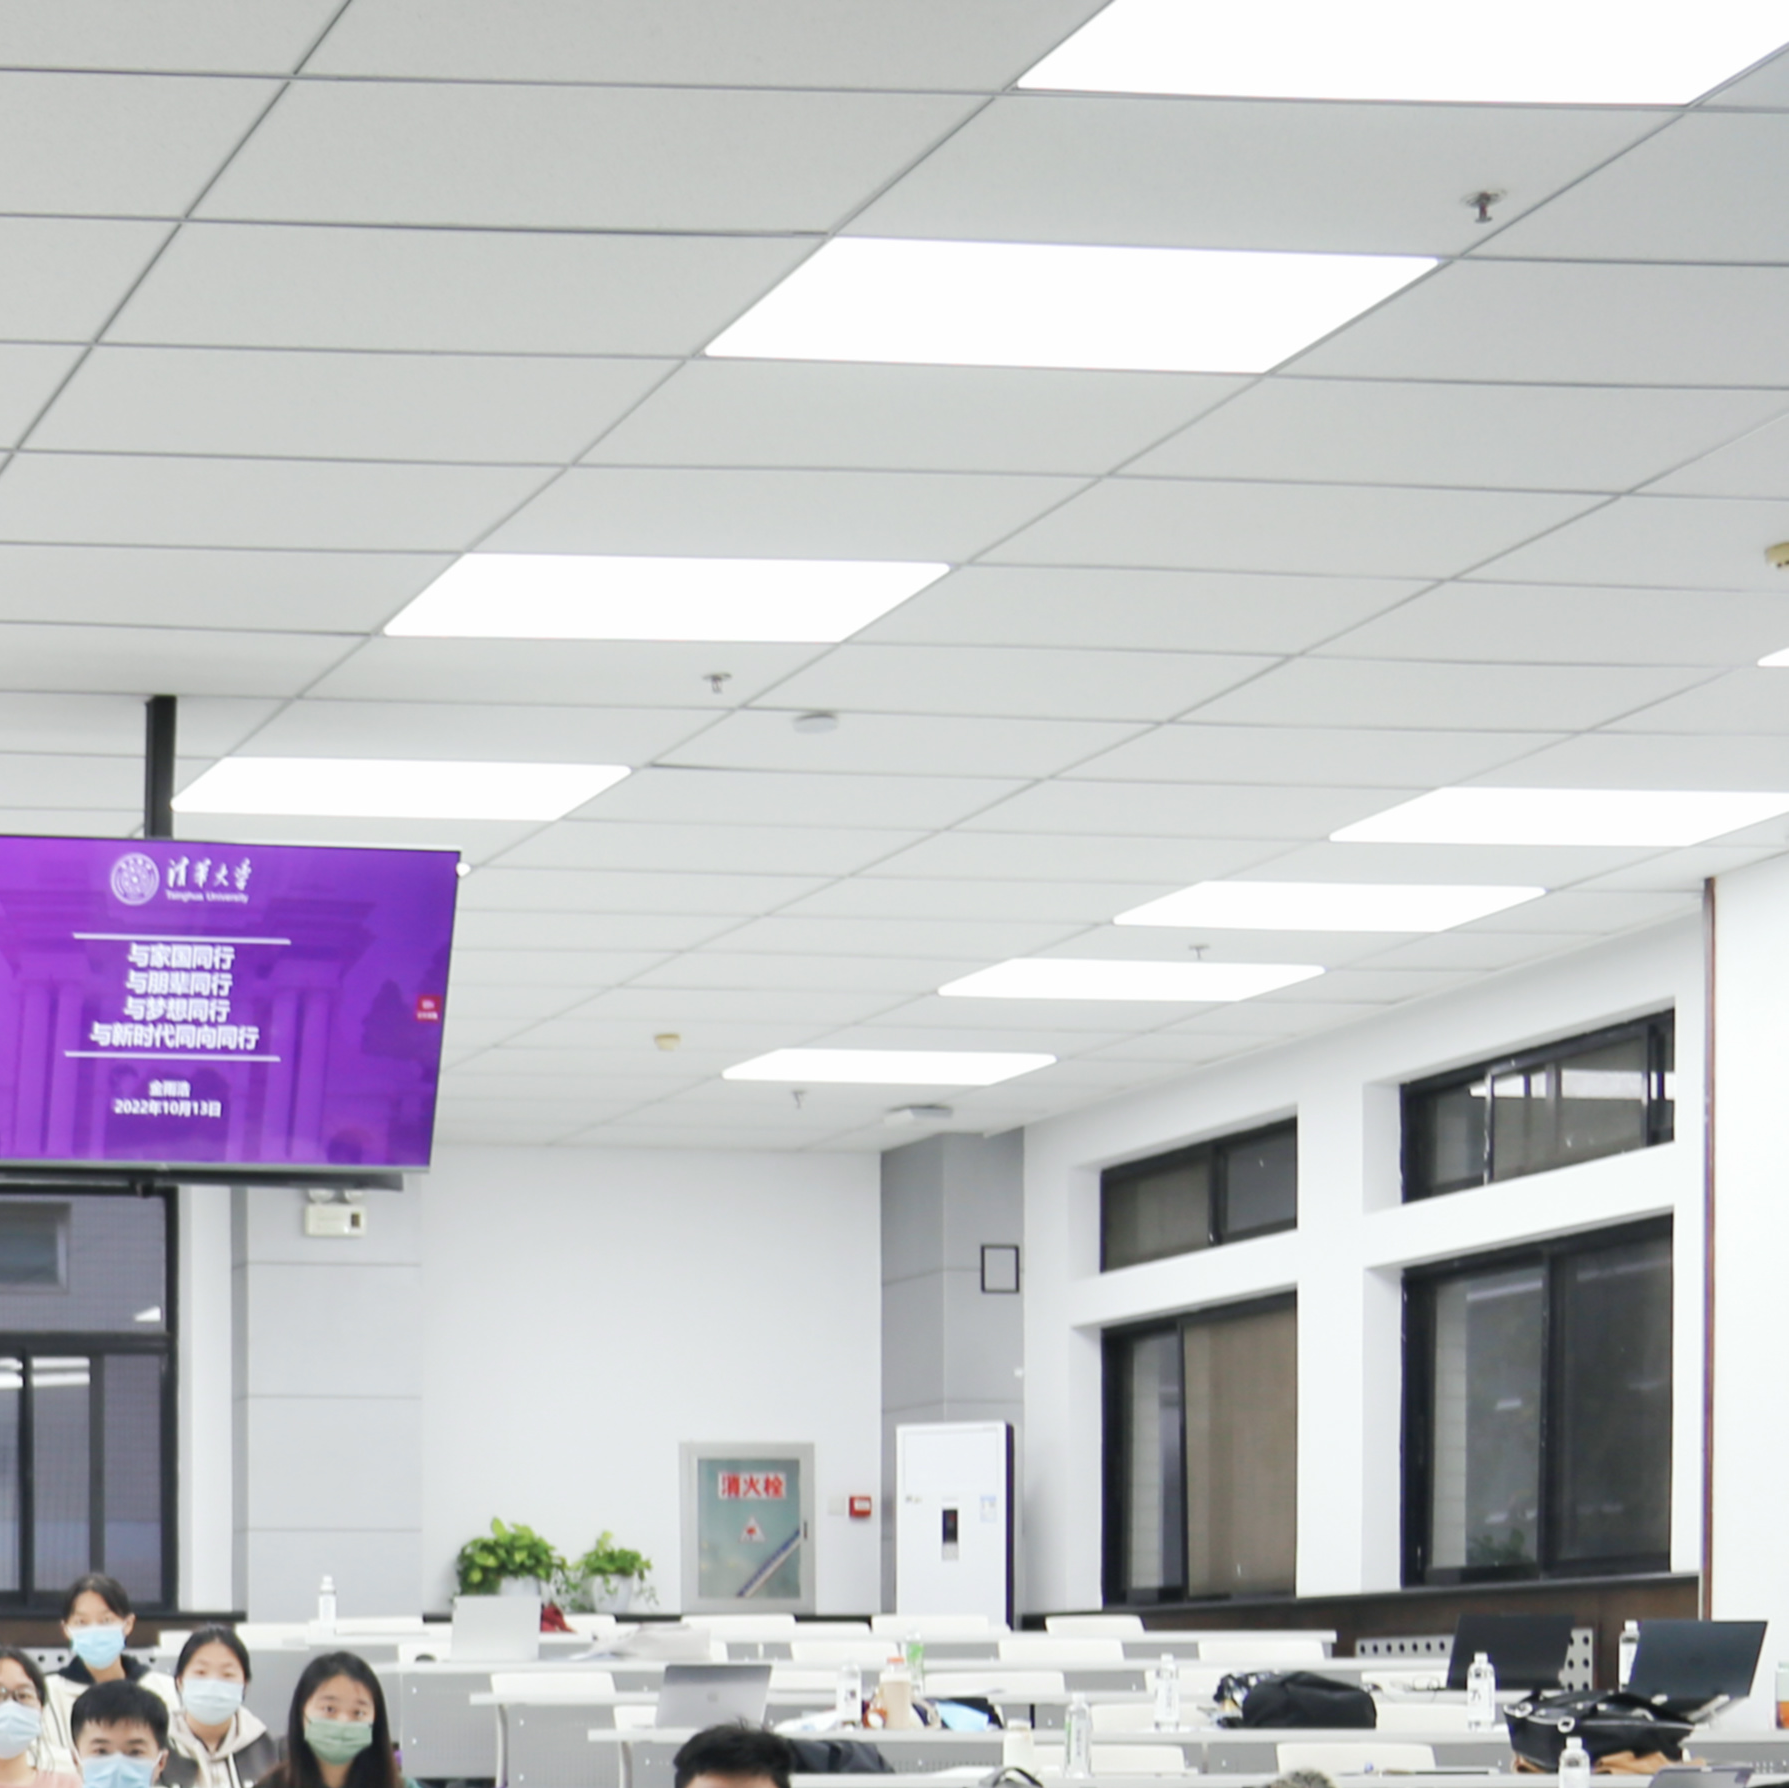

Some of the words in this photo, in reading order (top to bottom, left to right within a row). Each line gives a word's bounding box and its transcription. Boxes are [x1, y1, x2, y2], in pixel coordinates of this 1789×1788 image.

[127, 942, 235, 970] 与家国同行
[125, 968, 233, 997] 与朋辈同行
[123, 995, 231, 1023] 与梦想同行
[89, 1021, 260, 1050] 与新时代同向同行
[113, 1098, 222, 1117] 2022年10月13日
[721, 1473, 785, 1498] 消火栓
